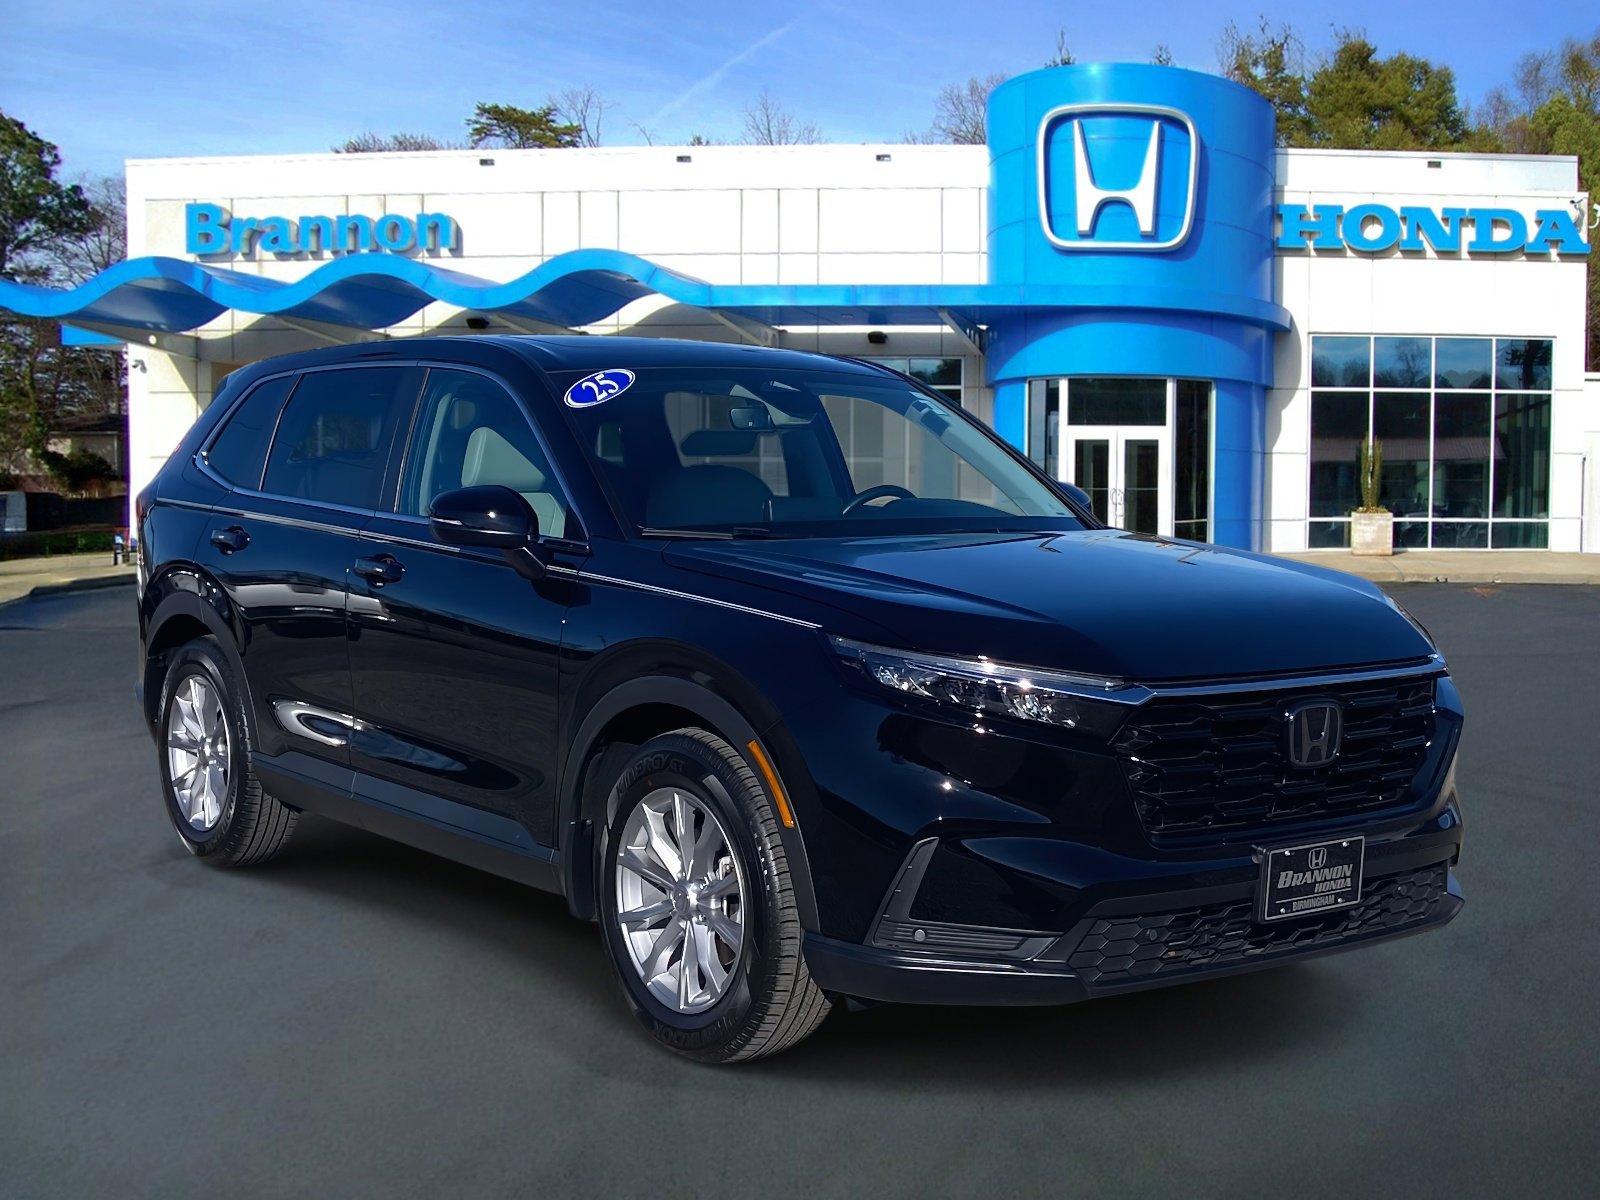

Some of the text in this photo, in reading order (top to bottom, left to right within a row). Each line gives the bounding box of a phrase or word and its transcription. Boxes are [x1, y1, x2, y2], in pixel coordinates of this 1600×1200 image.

[185, 202, 459, 255] Brannon
[1276, 203, 1591, 254] HONDA
[581, 373, 619, 401] 25
[1277, 864, 1353, 888] BRANNON
[1315, 878, 1352, 893] HONDA
[1292, 895, 1335, 911] BIRMINGHAM
